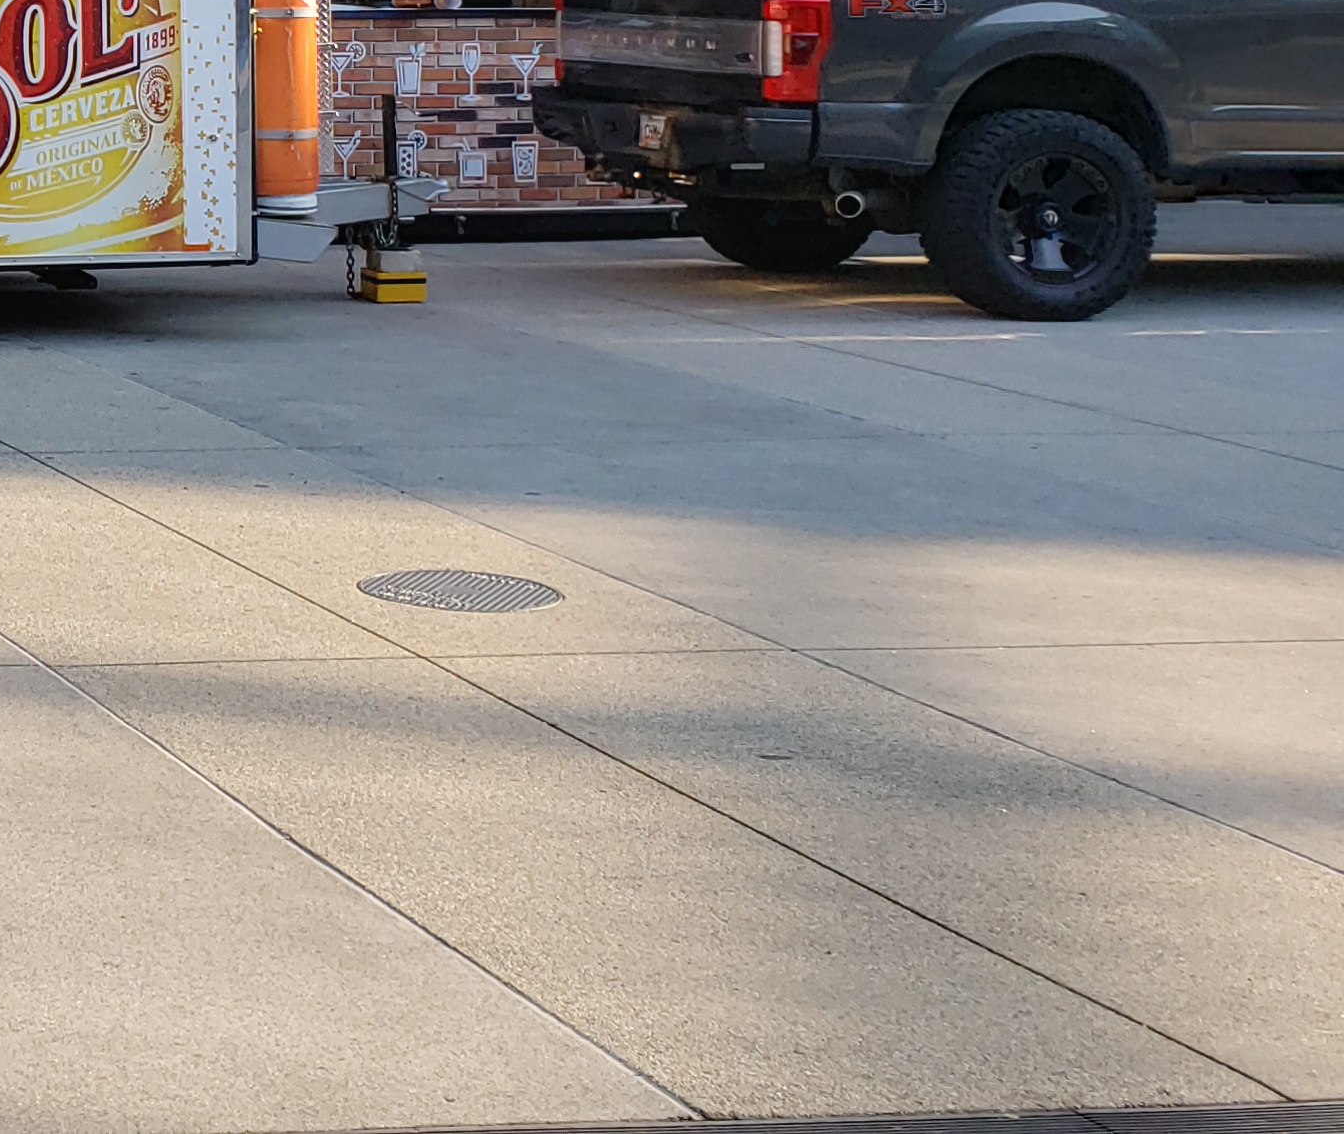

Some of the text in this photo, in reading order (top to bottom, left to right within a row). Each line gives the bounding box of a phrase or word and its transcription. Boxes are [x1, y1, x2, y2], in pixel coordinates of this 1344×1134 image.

[144, 24, 177, 52] 1899
[28, 83, 138, 134] CERVEZA
[35, 129, 122, 167] ORIGINAL
